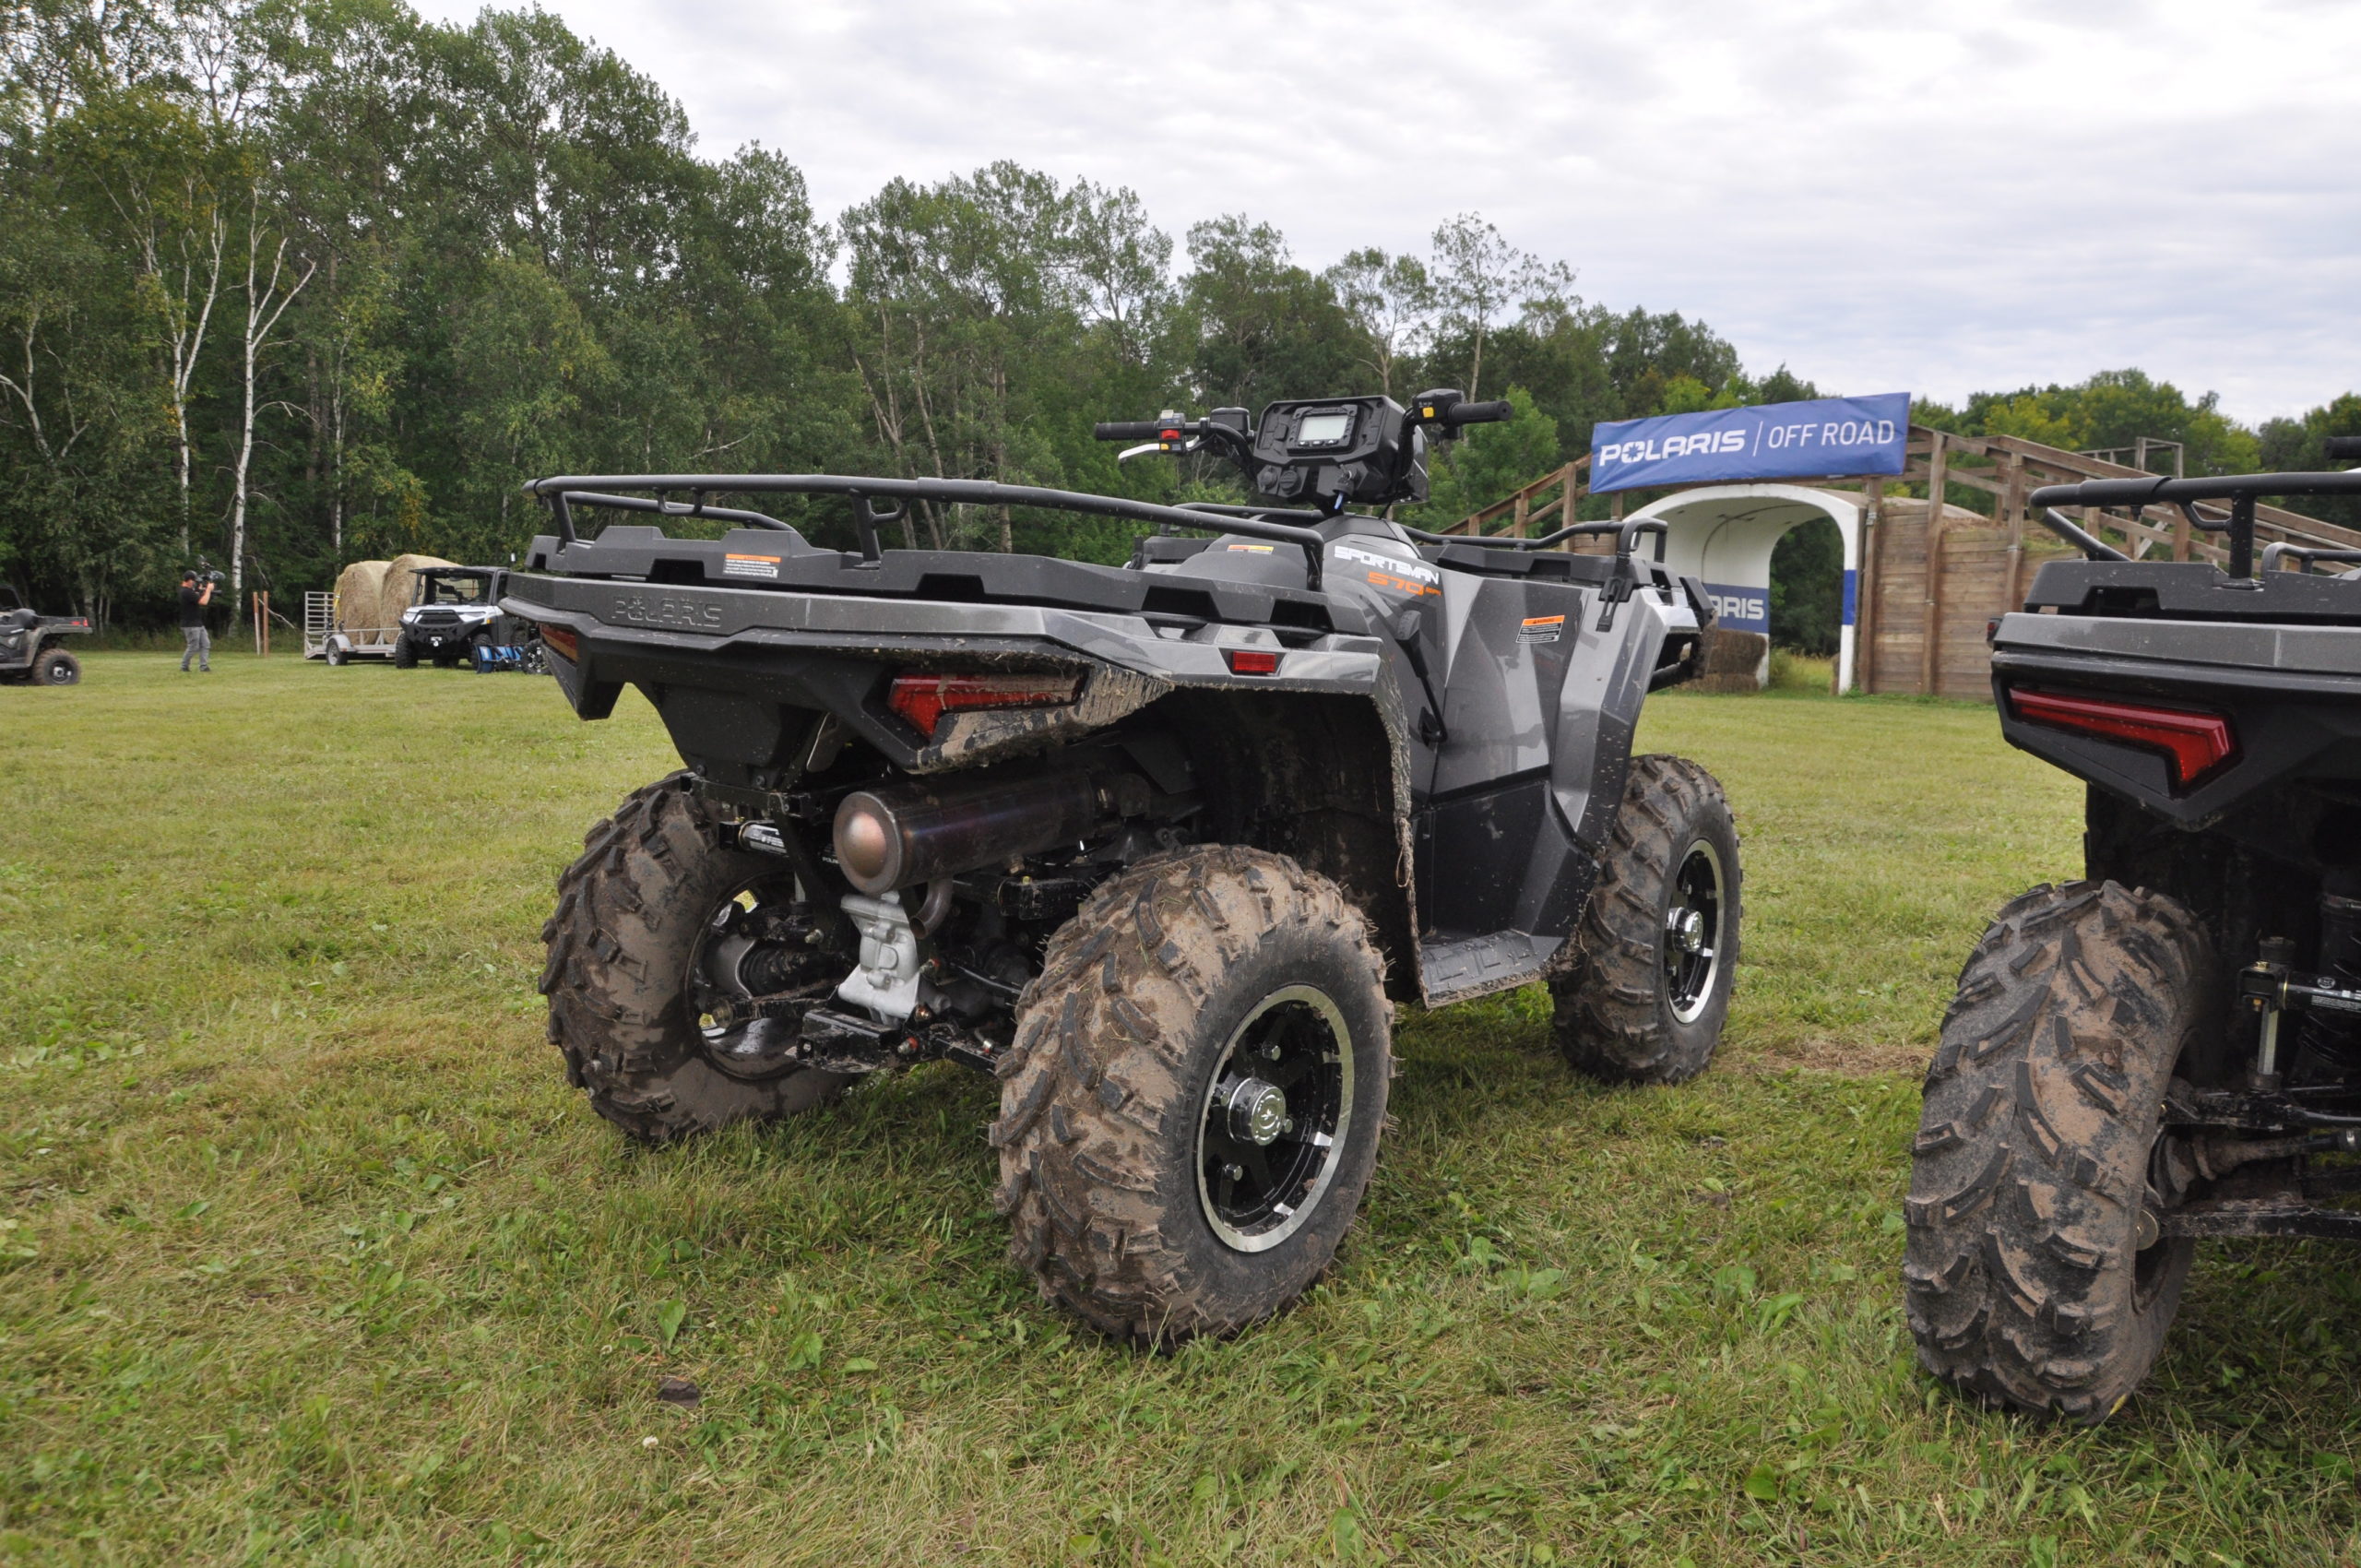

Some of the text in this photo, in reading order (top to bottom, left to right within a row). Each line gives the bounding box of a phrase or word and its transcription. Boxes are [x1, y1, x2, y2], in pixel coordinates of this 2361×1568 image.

[1599, 420, 1895, 467] POLARIS OFF ROAD
[1335, 545, 1439, 585] SPORTSMAN
[1368, 571, 1425, 596] 570
[611, 596, 722, 628] POLARIS
[1708, 595, 1764, 621] ARIS
